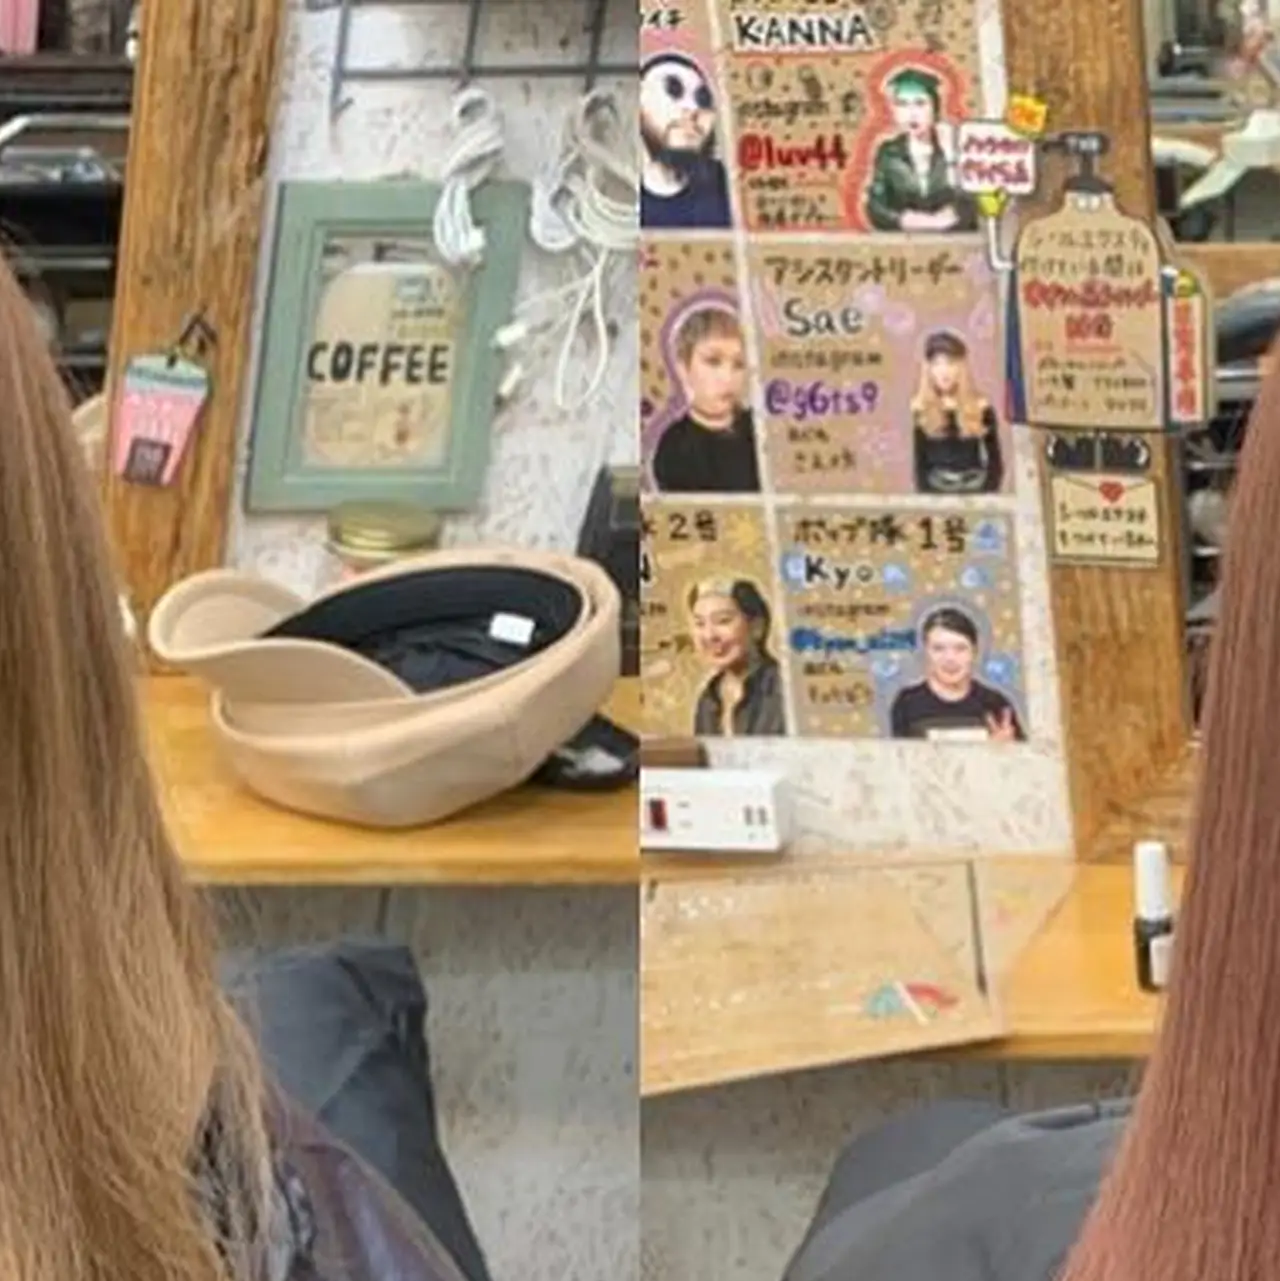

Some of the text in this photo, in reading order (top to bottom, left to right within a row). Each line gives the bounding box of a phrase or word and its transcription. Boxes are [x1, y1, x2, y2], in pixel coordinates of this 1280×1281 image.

[734, 14, 874, 45] KANNA
[783, 298, 864, 336] Sae
[306, 340, 450, 388] COFFEE
[804, 554, 875, 590] Kyo
